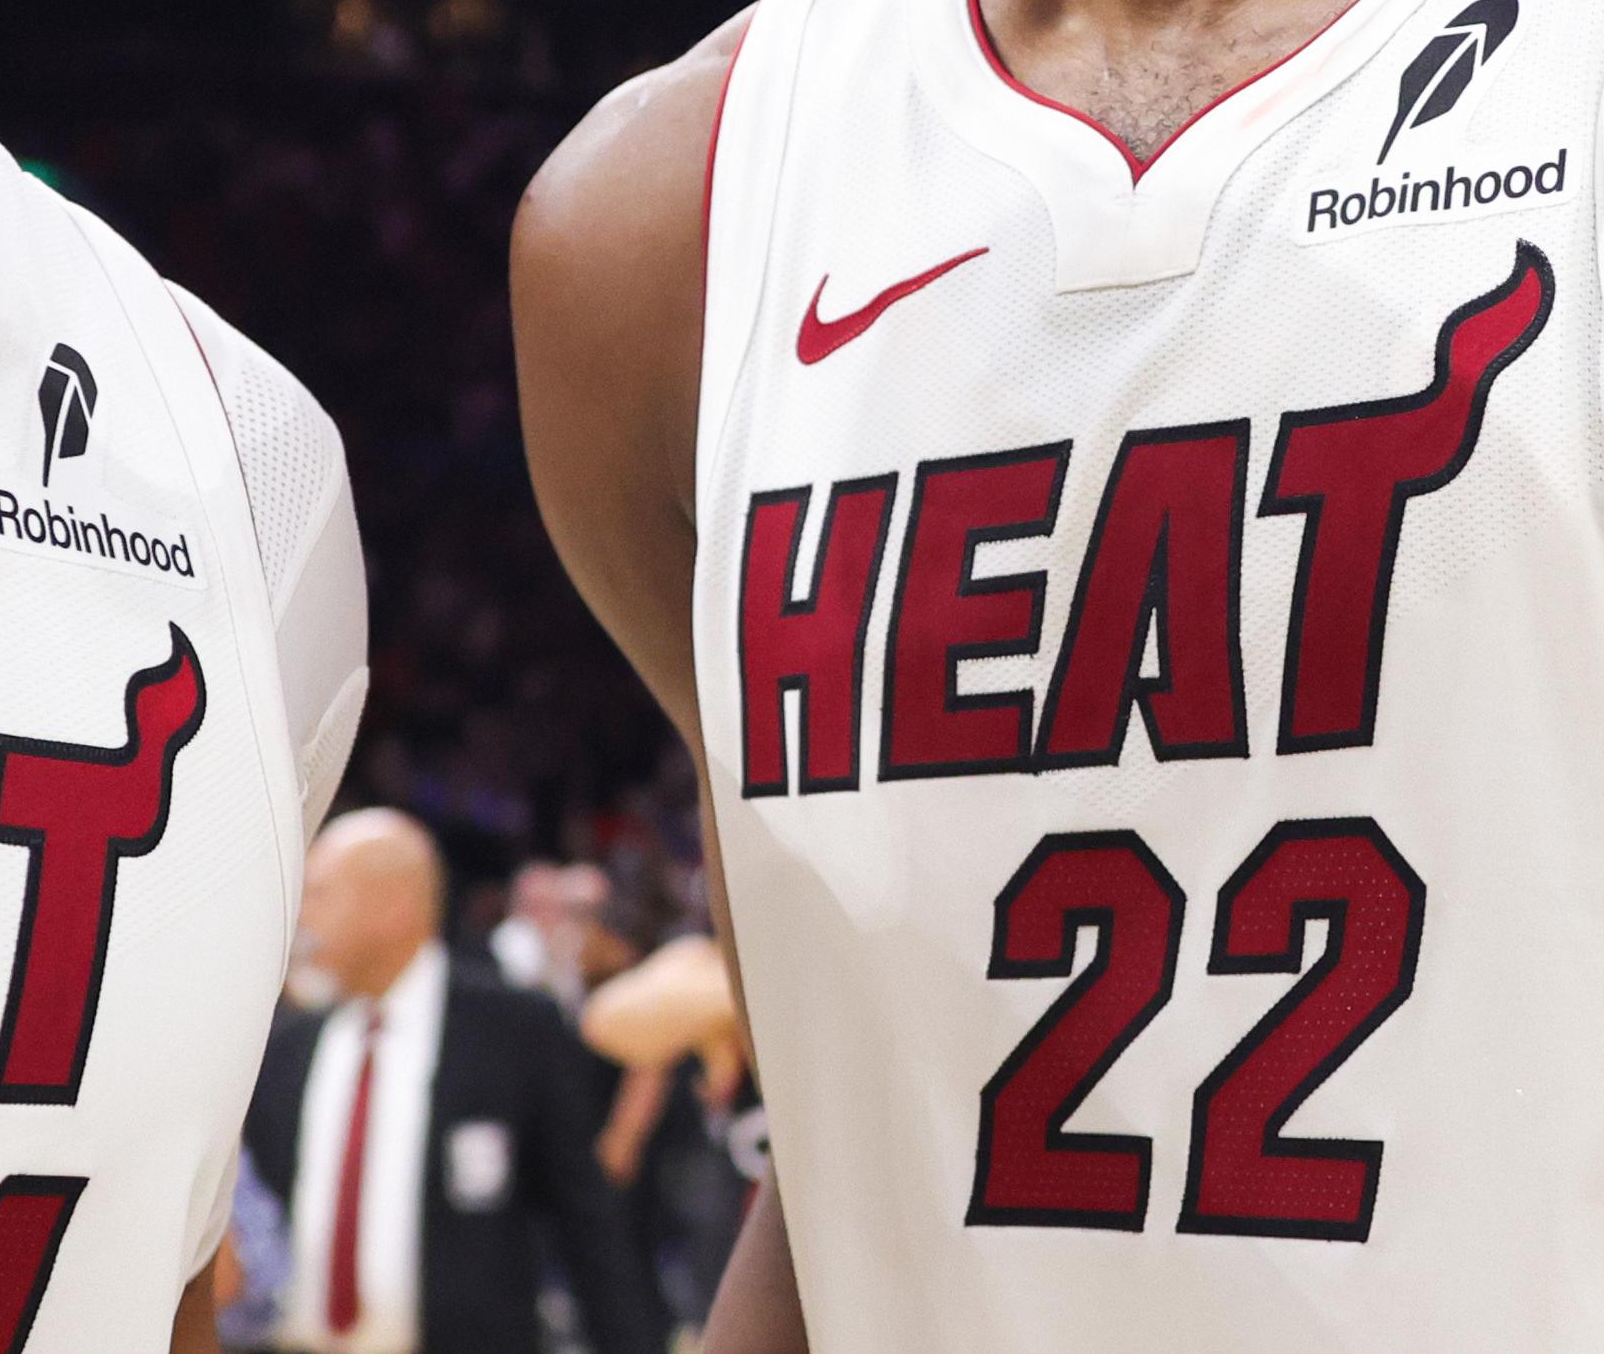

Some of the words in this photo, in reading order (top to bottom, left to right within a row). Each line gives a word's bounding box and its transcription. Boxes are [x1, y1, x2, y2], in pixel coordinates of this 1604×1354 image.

[1307, 148, 1567, 233] Robinhood
[737, 238, 1555, 799] HEAT
[964, 816, 1427, 1243] 22
